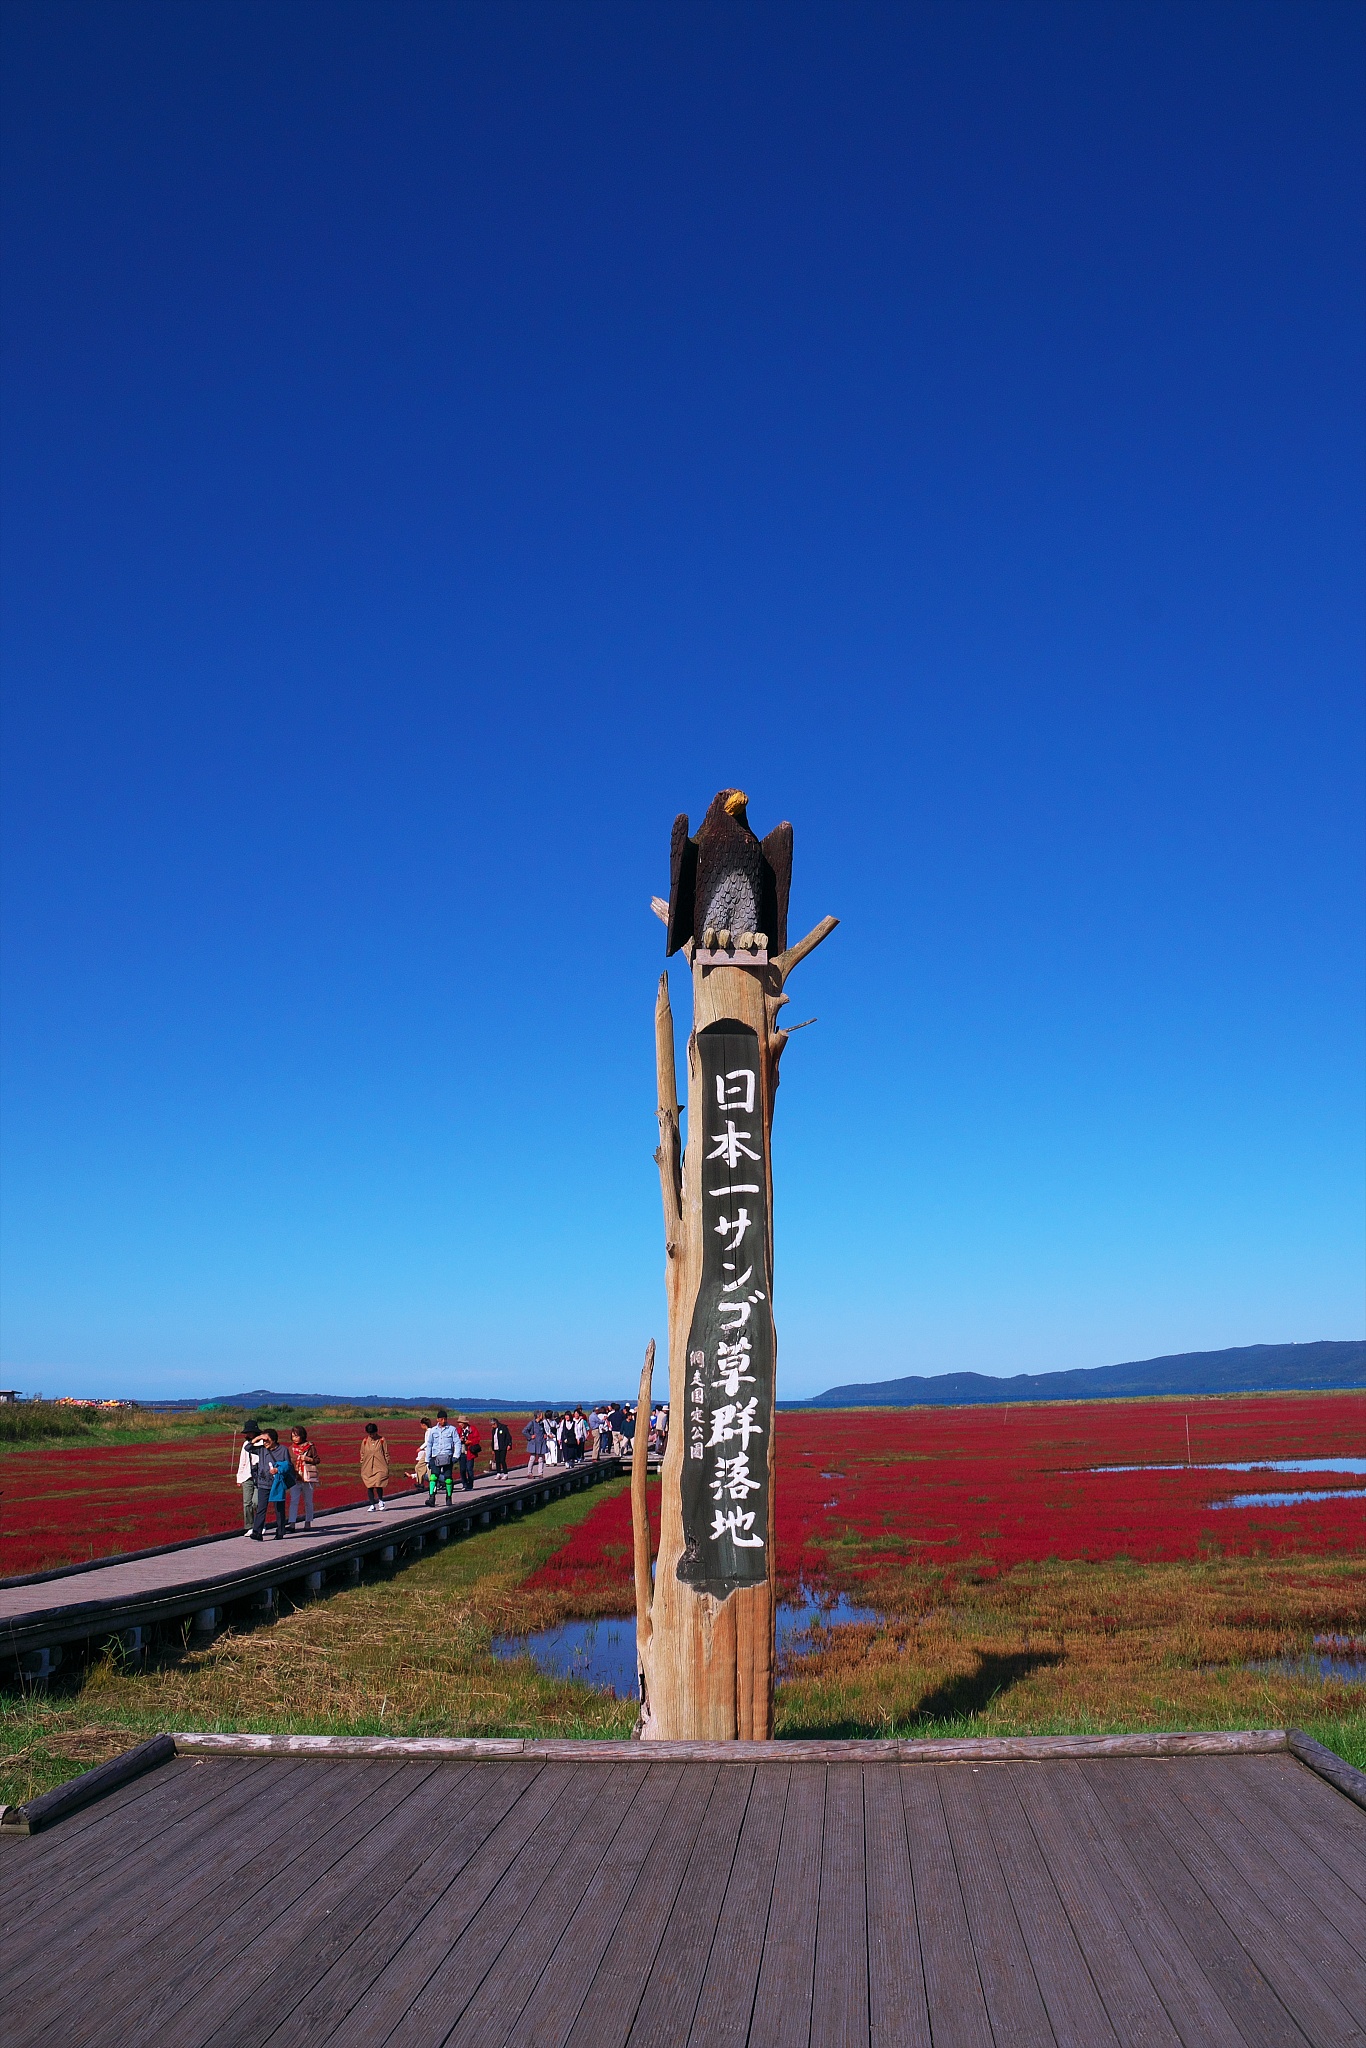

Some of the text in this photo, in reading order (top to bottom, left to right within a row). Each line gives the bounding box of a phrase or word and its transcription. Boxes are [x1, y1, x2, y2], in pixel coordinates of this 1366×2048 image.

[706, 1069, 764, 1548] 日本一サンゴ草群落地
